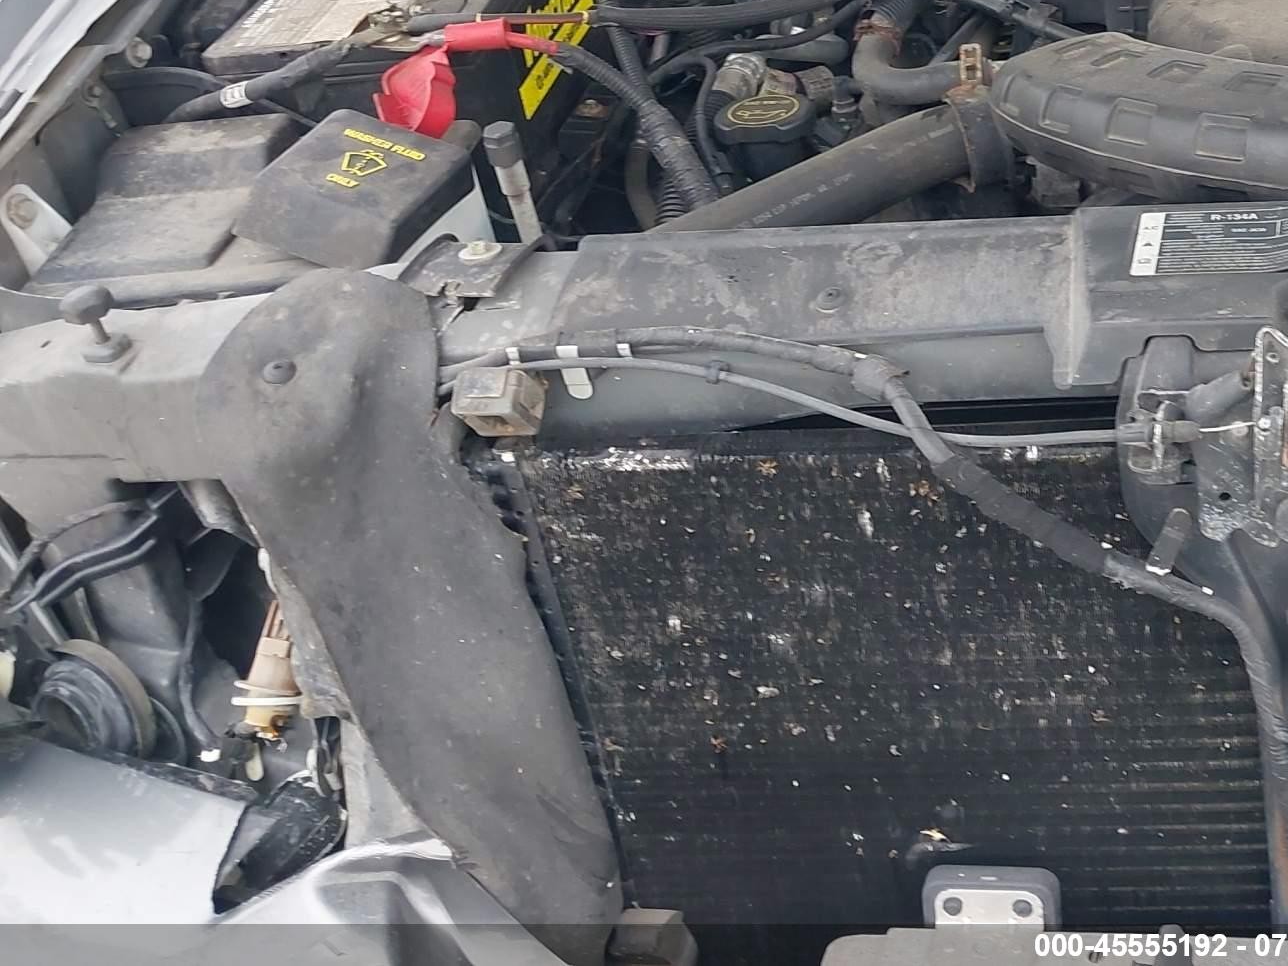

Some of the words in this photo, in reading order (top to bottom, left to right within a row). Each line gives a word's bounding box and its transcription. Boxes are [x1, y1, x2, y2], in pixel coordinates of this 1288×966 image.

[343, 128, 393, 149] WASHER
[390, 144, 426, 161] FLUID
[325, 173, 360, 188] ONLY
[1210, 213, 1259, 221] R-134A
